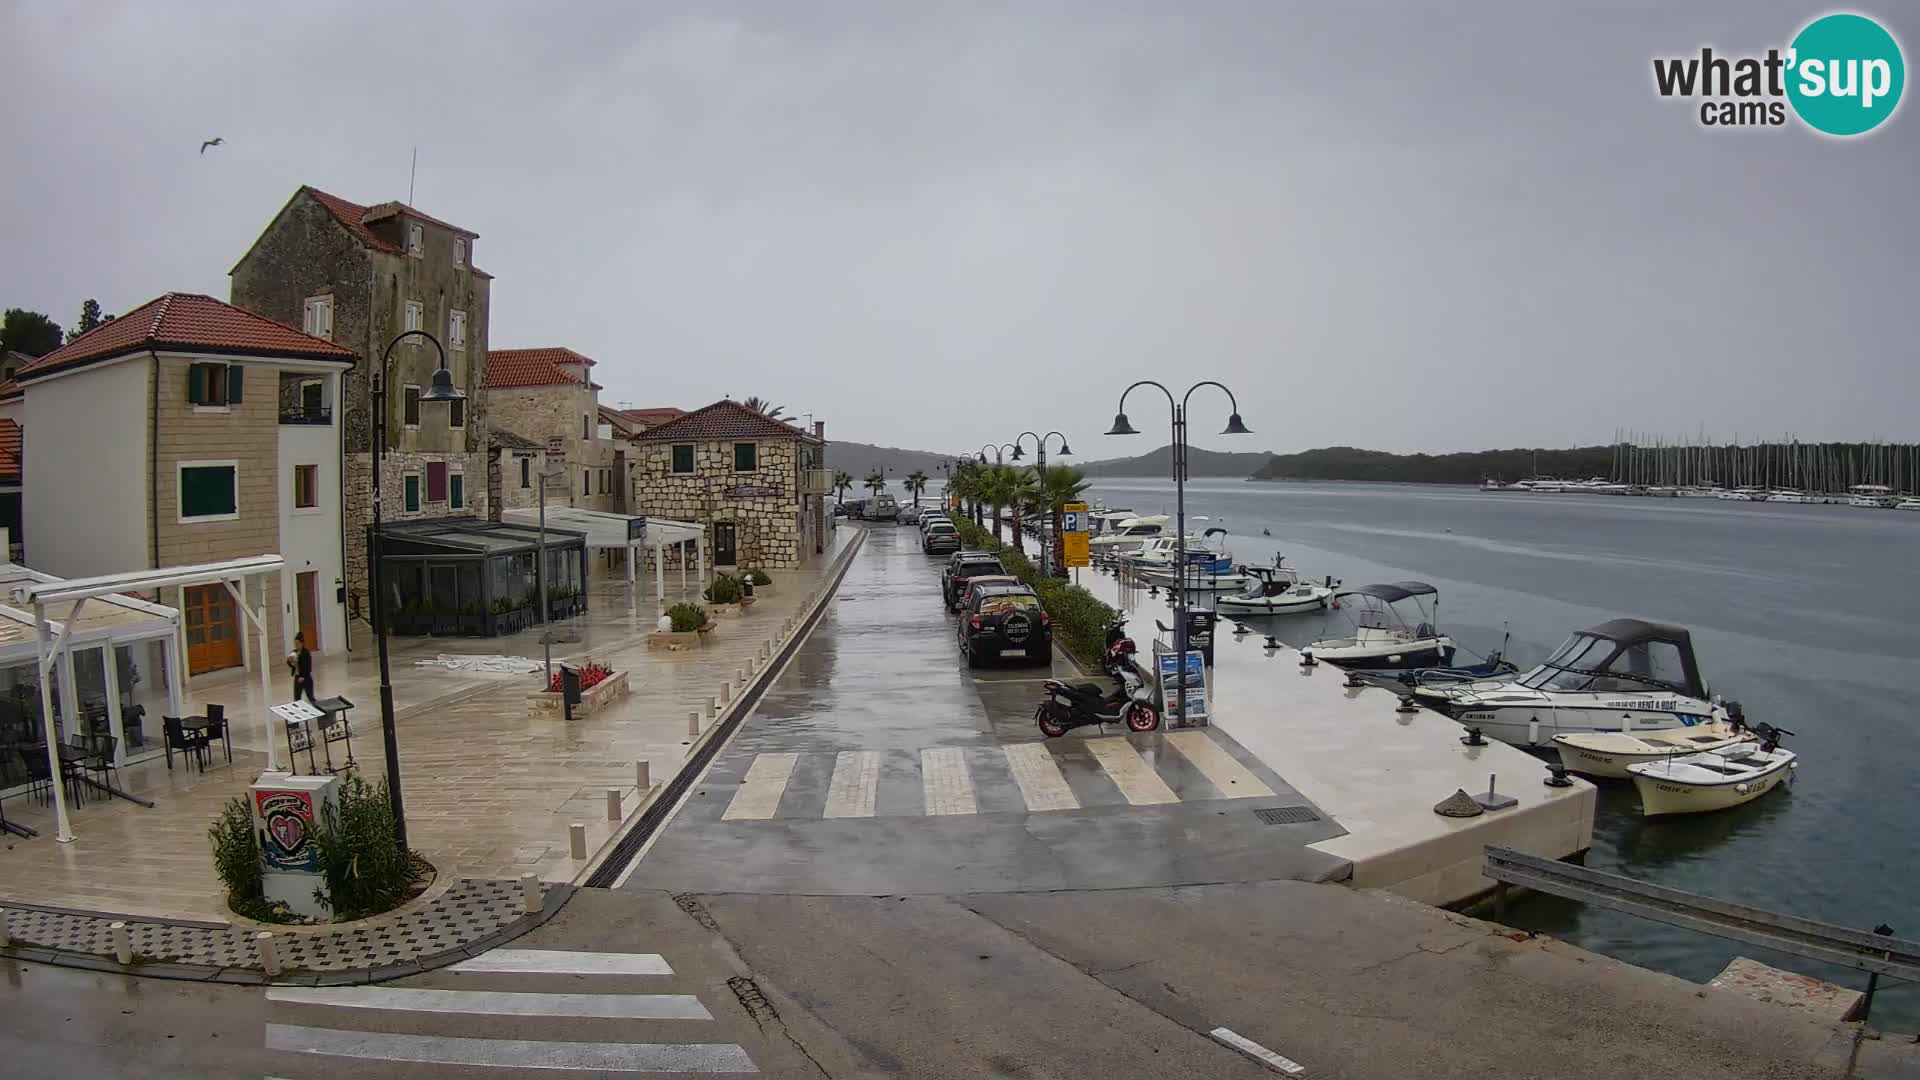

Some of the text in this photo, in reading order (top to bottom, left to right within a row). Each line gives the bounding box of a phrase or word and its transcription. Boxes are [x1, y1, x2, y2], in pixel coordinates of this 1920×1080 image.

[1065, 514, 1076, 530] P
[1637, 700, 1655, 710] RENT
[1660, 700, 1677, 711] BOAT
